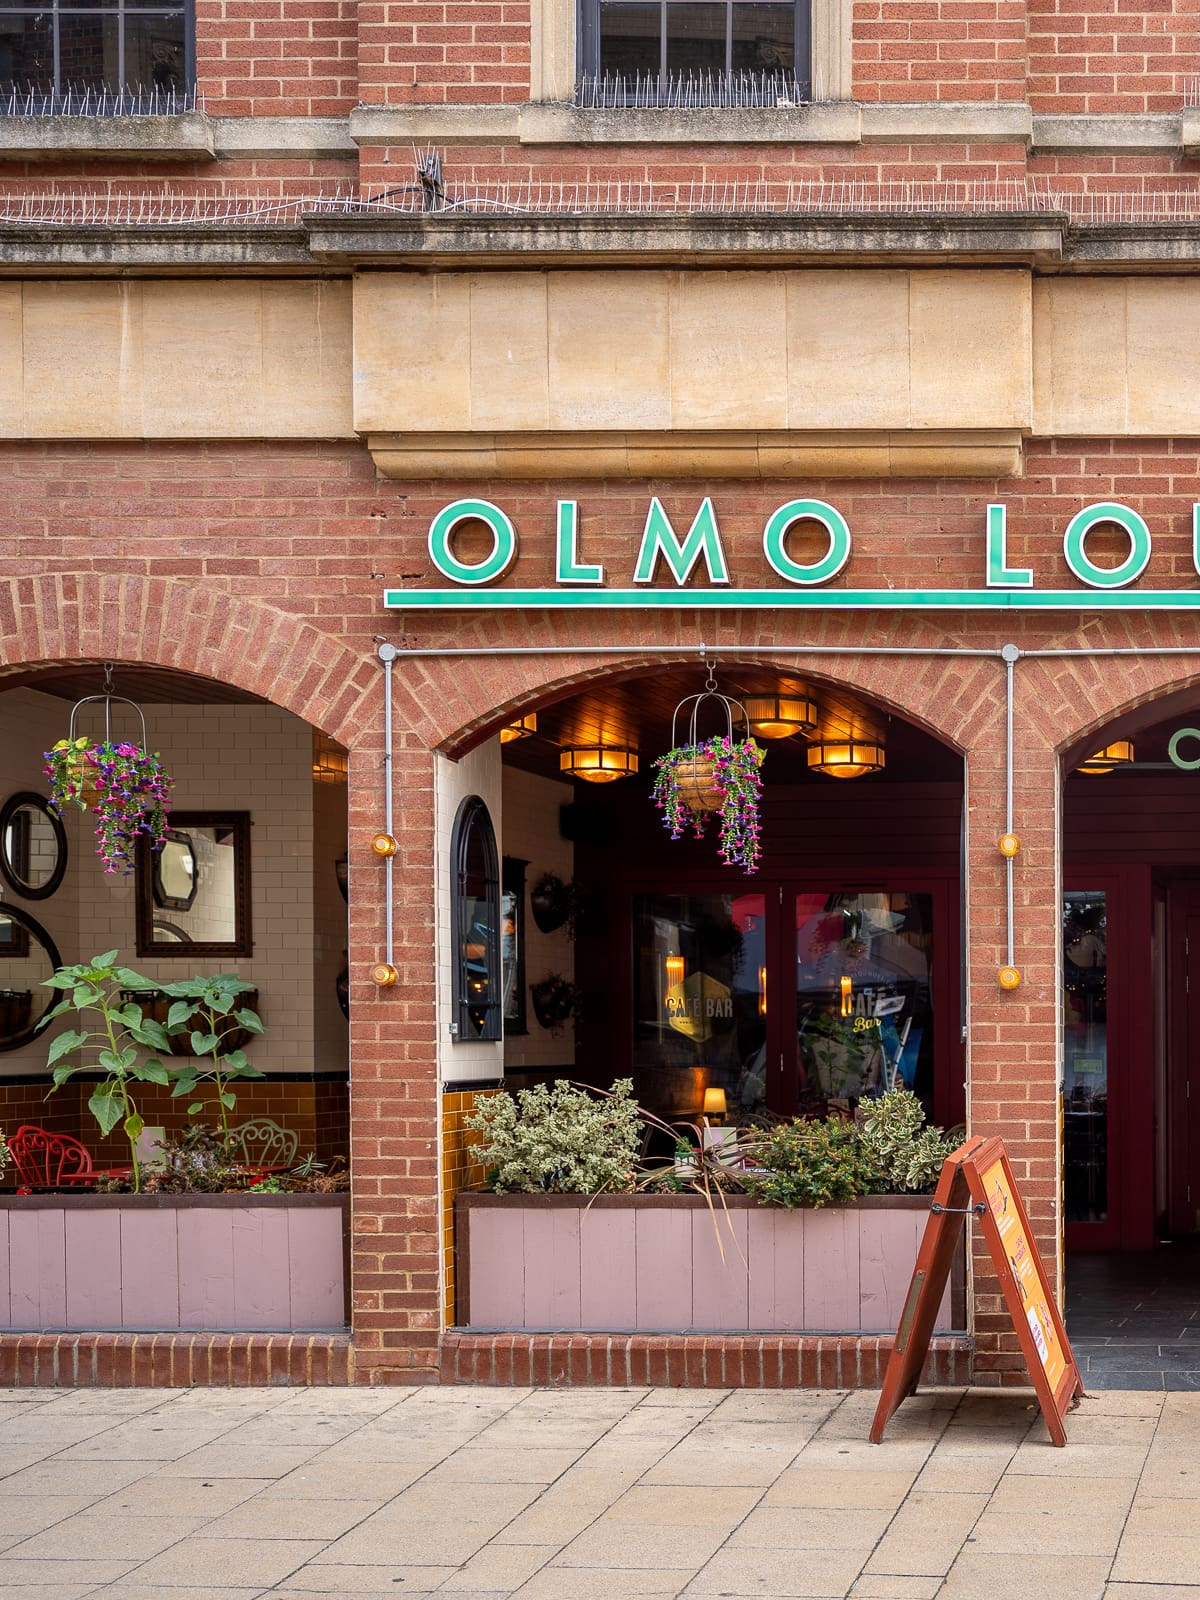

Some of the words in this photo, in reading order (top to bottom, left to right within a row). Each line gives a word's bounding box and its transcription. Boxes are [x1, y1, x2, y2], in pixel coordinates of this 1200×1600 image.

[427, 496, 853, 586] OLMO
[665, 992, 701, 1018] CAFÉ
[706, 998, 734, 1018] BAR
[852, 1016, 882, 1033] Bar
